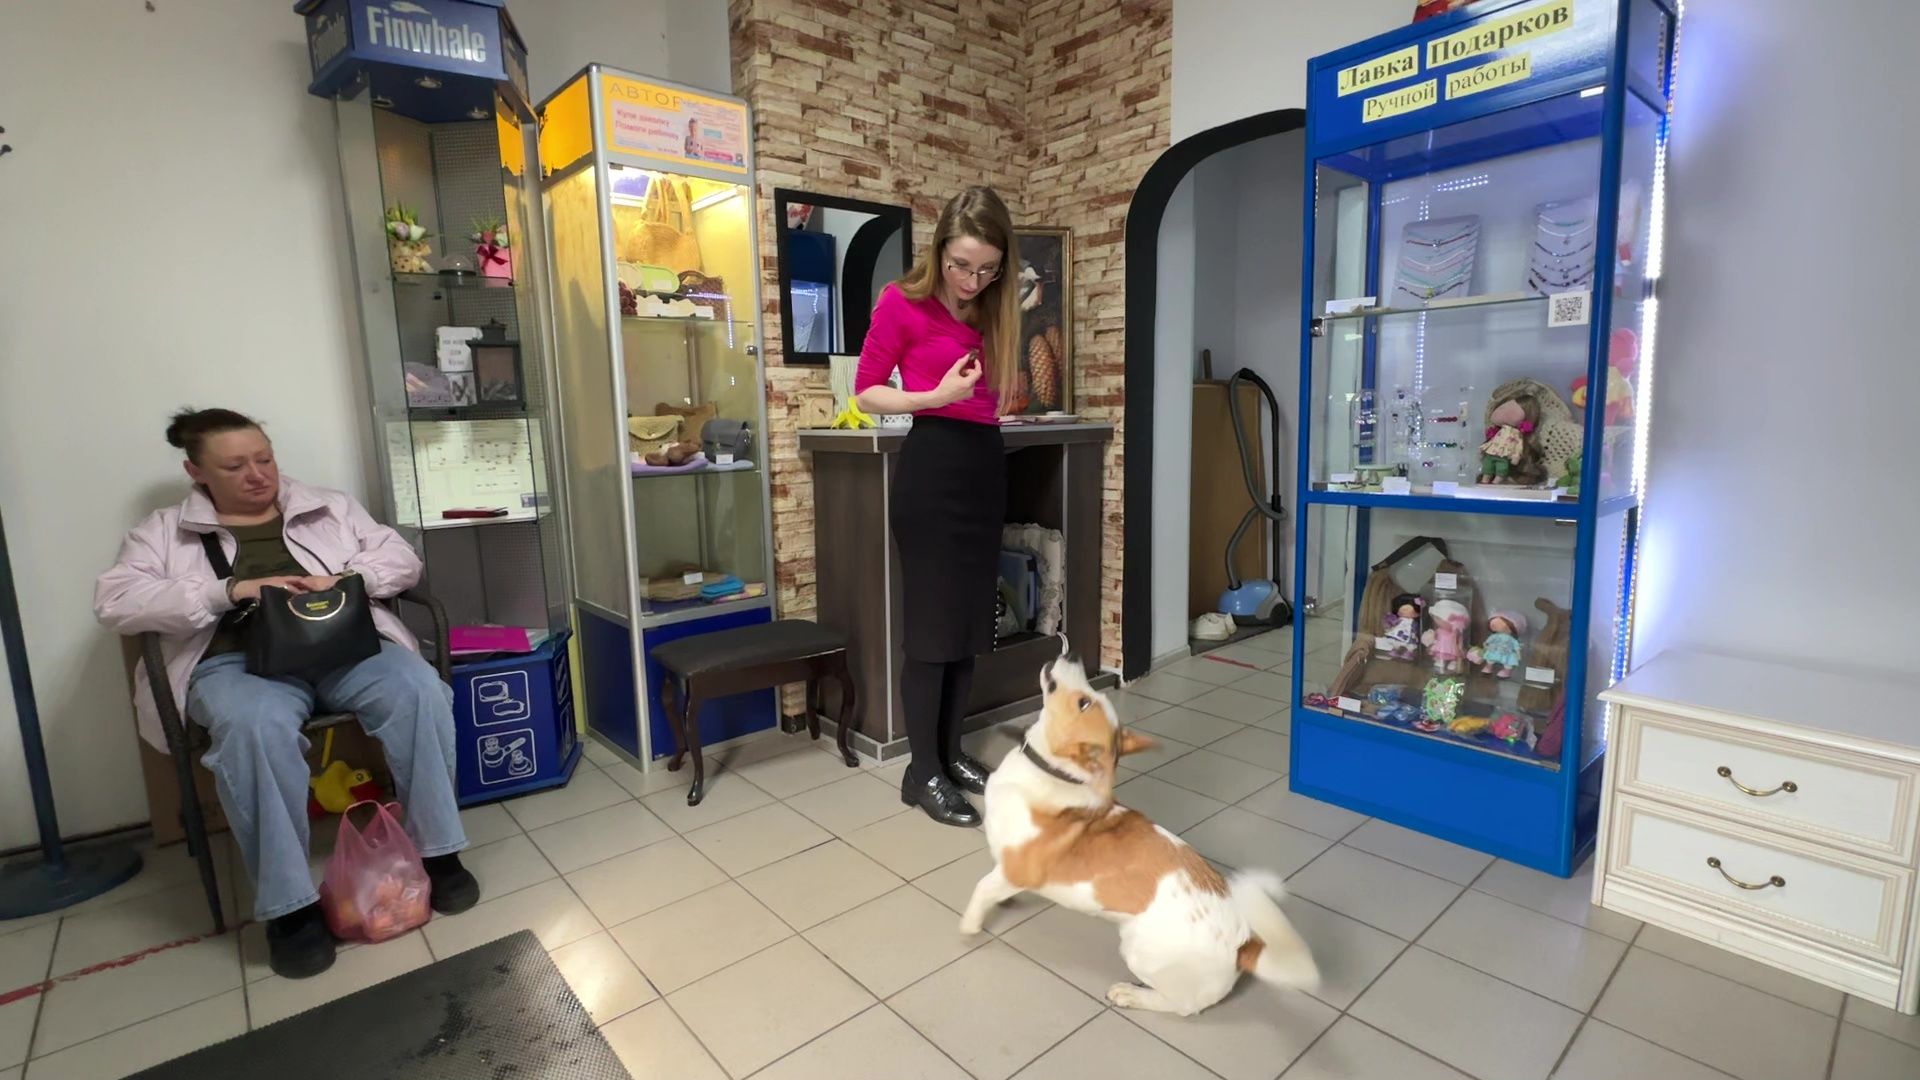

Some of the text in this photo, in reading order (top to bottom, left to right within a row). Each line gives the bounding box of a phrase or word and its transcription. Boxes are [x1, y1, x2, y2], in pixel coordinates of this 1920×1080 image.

[366, 6, 487, 63] Finwhale
[1340, 4, 1569, 91] Лавка Подарков
[1366, 56, 1528, 117] Ручной работы
